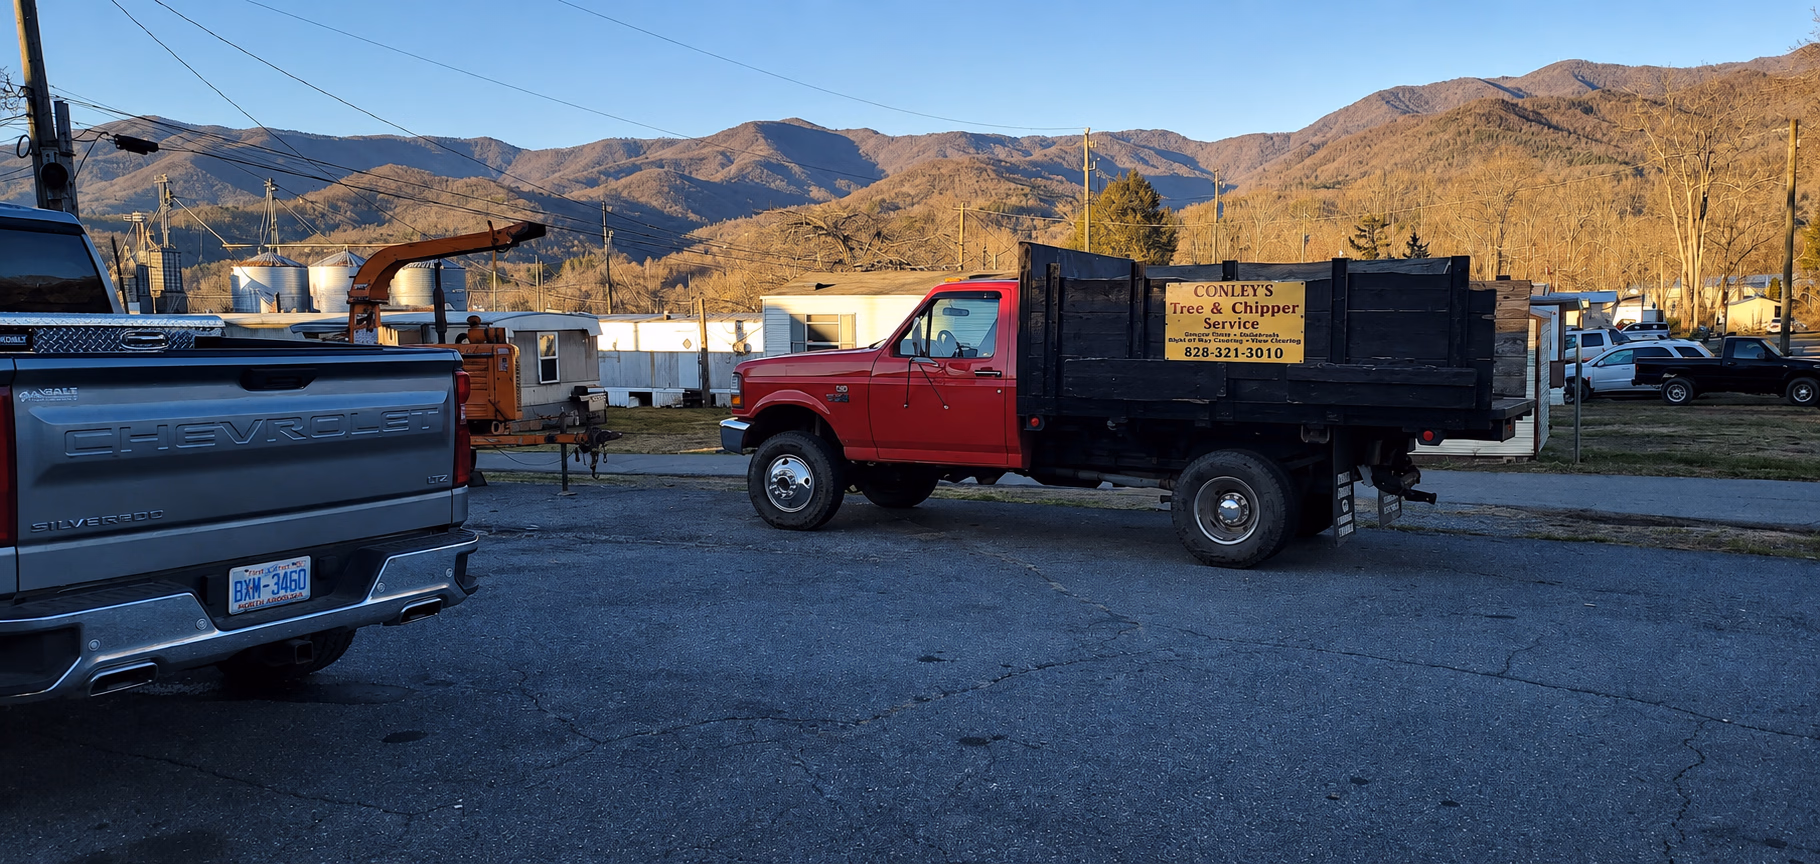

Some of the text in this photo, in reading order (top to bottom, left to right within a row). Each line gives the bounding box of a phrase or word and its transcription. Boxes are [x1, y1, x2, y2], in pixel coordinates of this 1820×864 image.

[1193, 284, 1274, 298] CONLEY'S
[1170, 301, 1300, 317] Tree & Chipper
[1203, 317, 1259, 330] Service
[1184, 347, 1284, 359] 828-321-3010
[64, 408, 439, 457] CHEVROLET
[427, 474, 448, 484] LTZ
[233, 568, 307, 603] BXM-3460
